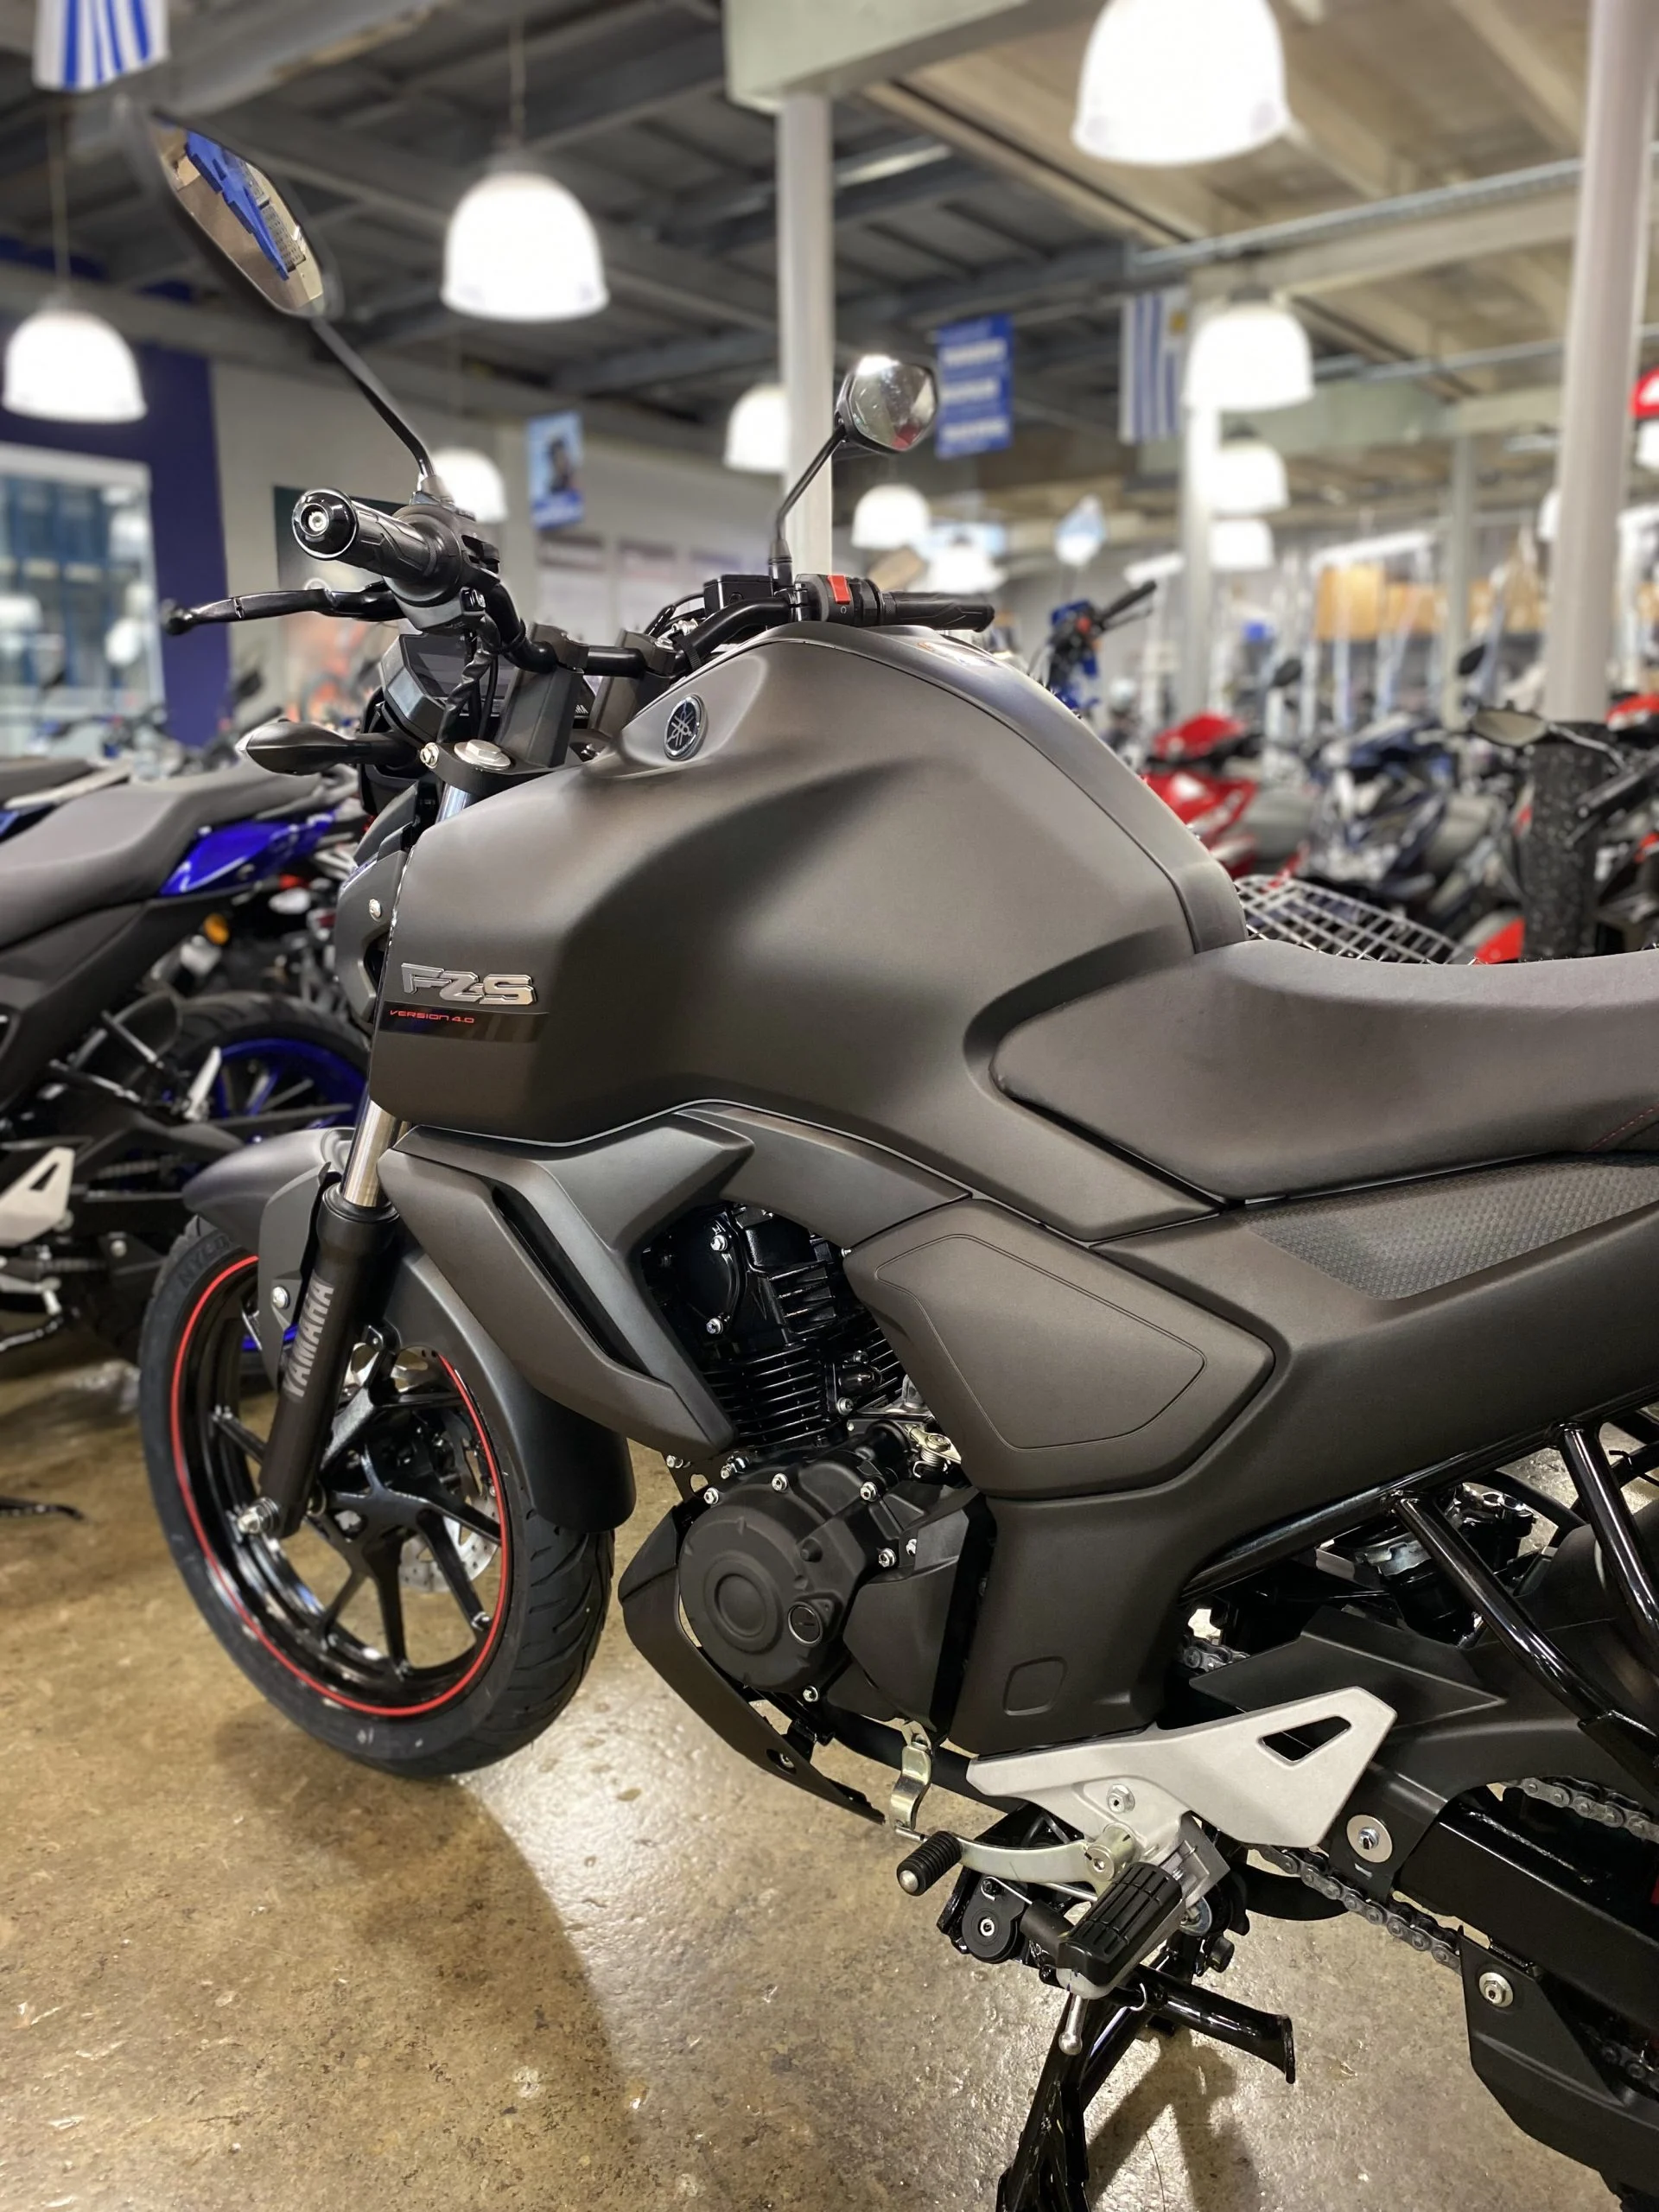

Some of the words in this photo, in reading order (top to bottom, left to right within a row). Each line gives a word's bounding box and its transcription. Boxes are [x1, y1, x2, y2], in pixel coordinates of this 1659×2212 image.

[401, 963, 537, 1006] FZS
[390, 1009, 449, 1021] VERSION
[282, 1278, 334, 1397] YAMAHA
